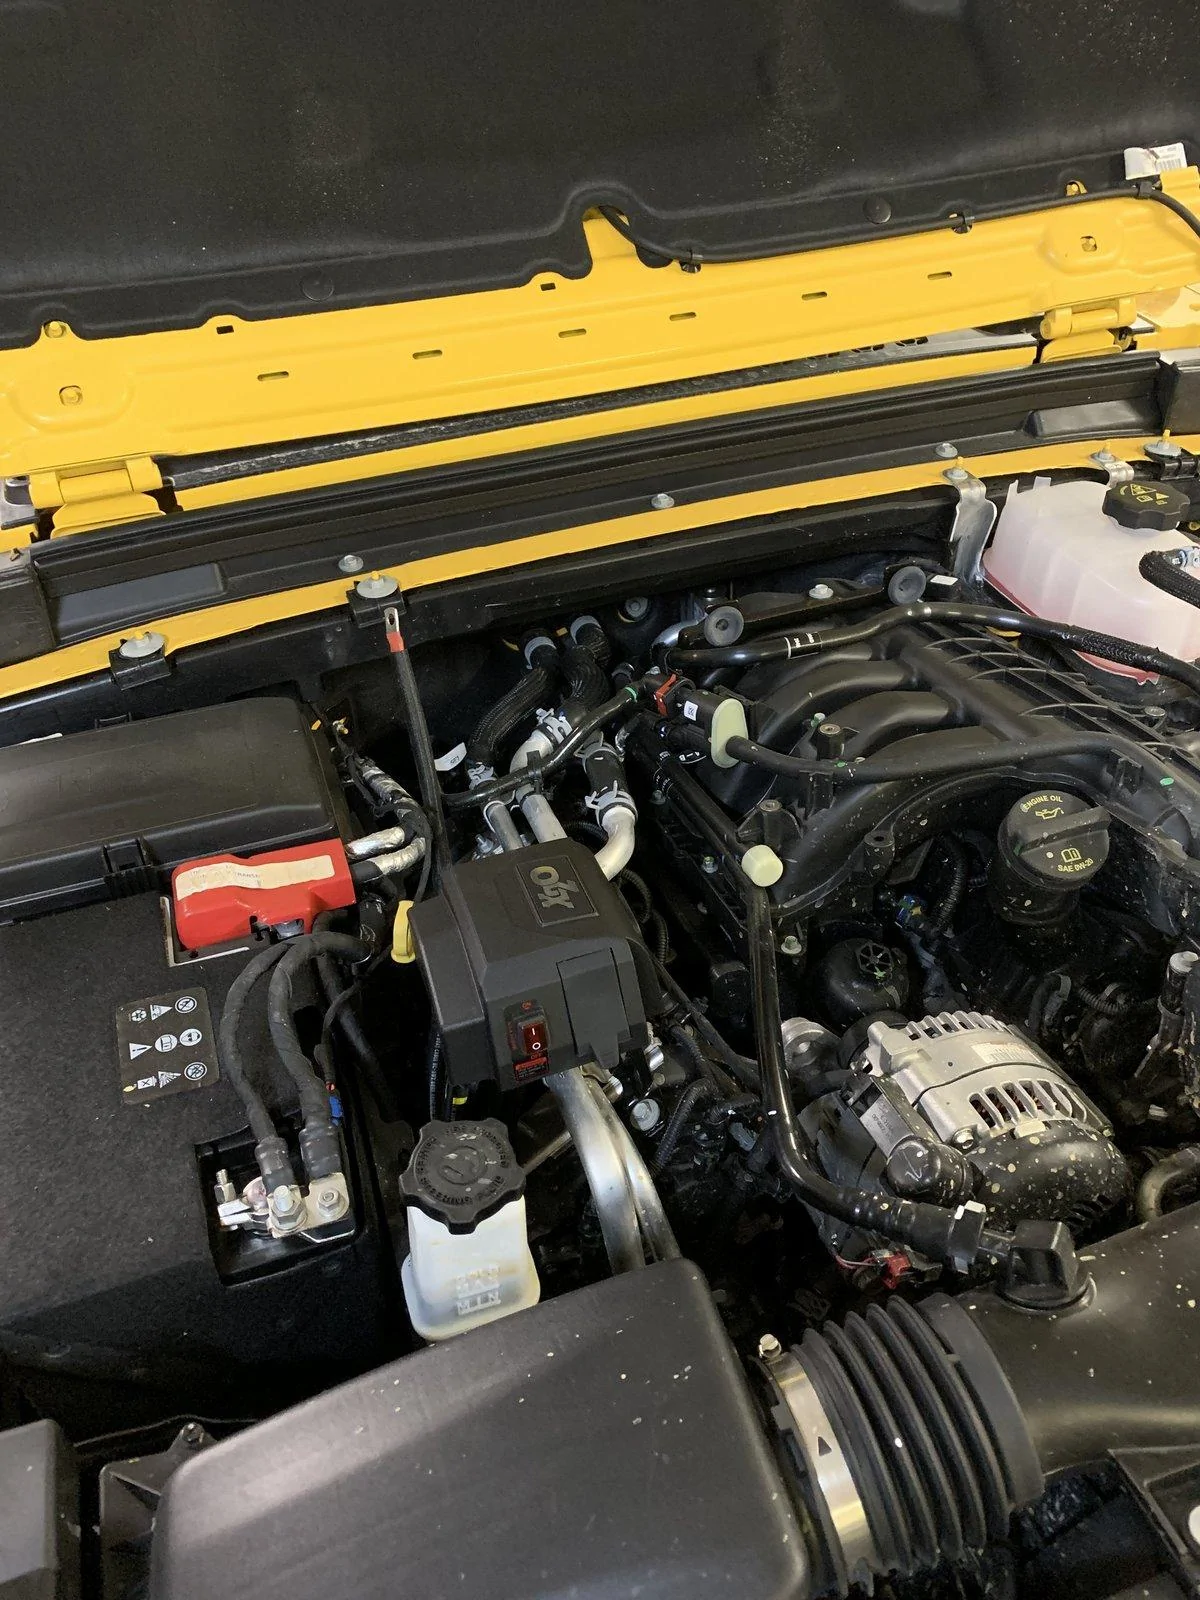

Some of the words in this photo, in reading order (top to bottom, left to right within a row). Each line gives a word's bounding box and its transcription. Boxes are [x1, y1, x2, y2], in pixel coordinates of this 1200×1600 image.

[1023, 795, 1049, 810] ENGINE
[1050, 794, 1063, 803] OIL
[1058, 864, 1074, 872] SAE
[1075, 858, 1094, 871] 0W-20
[456, 1291, 499, 1315] MIN
